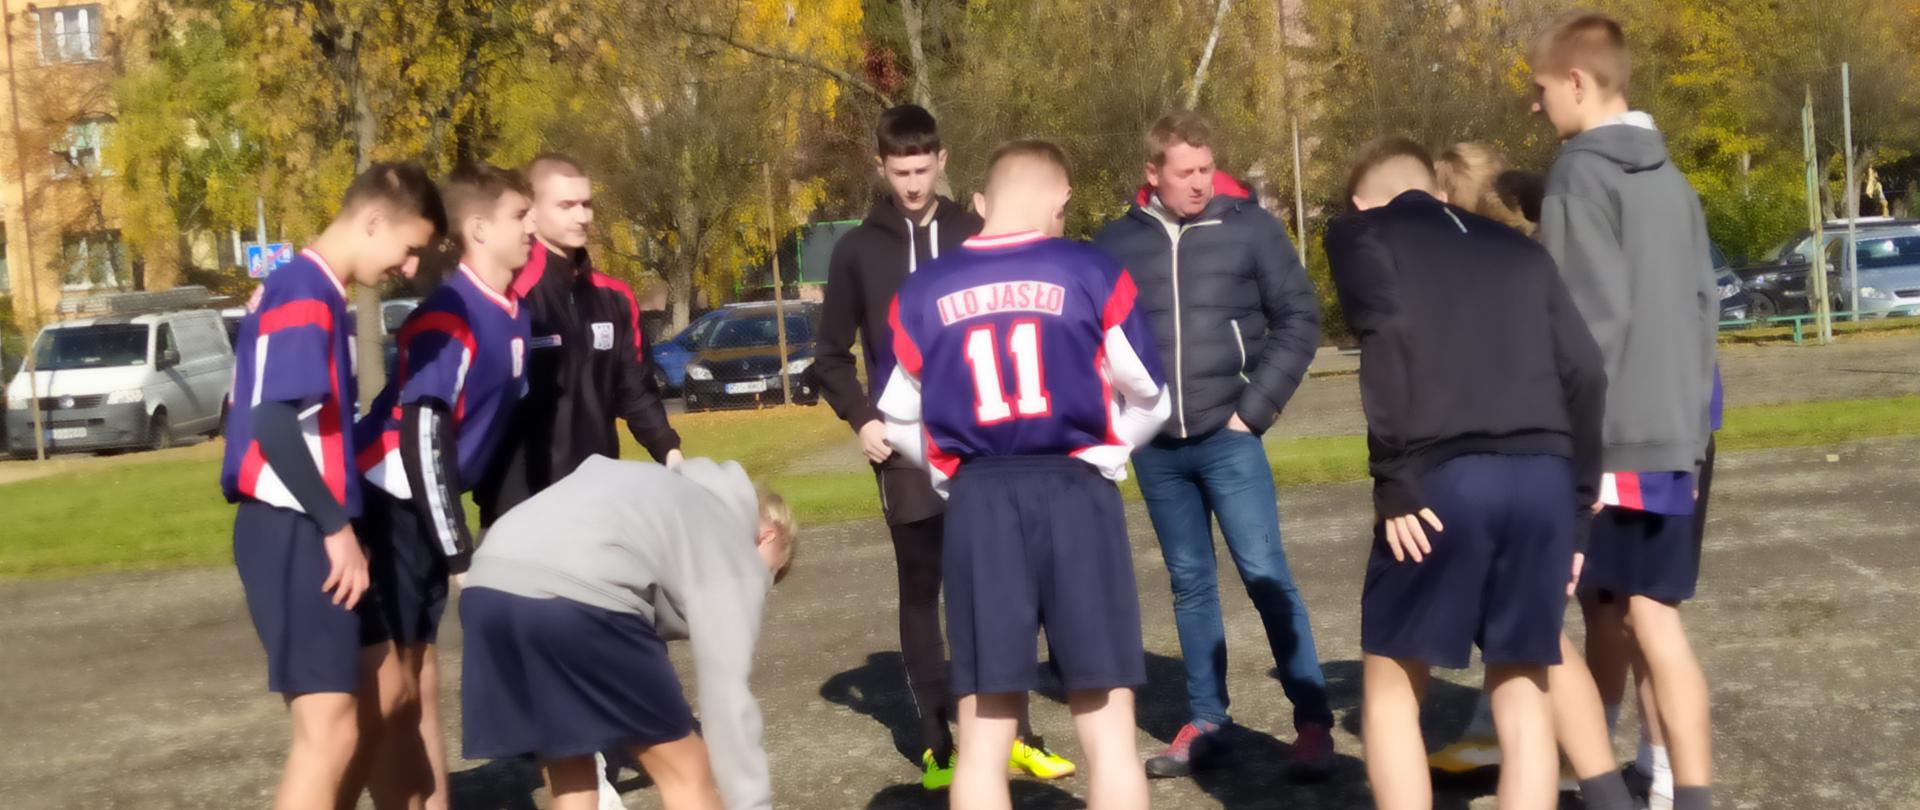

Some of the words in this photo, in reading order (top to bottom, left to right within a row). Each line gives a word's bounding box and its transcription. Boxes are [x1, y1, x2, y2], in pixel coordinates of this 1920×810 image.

[939, 299, 949, 323] I
[950, 290, 978, 319] LO
[987, 283, 1062, 312] JASŁO
[964, 319, 1050, 424] 11
